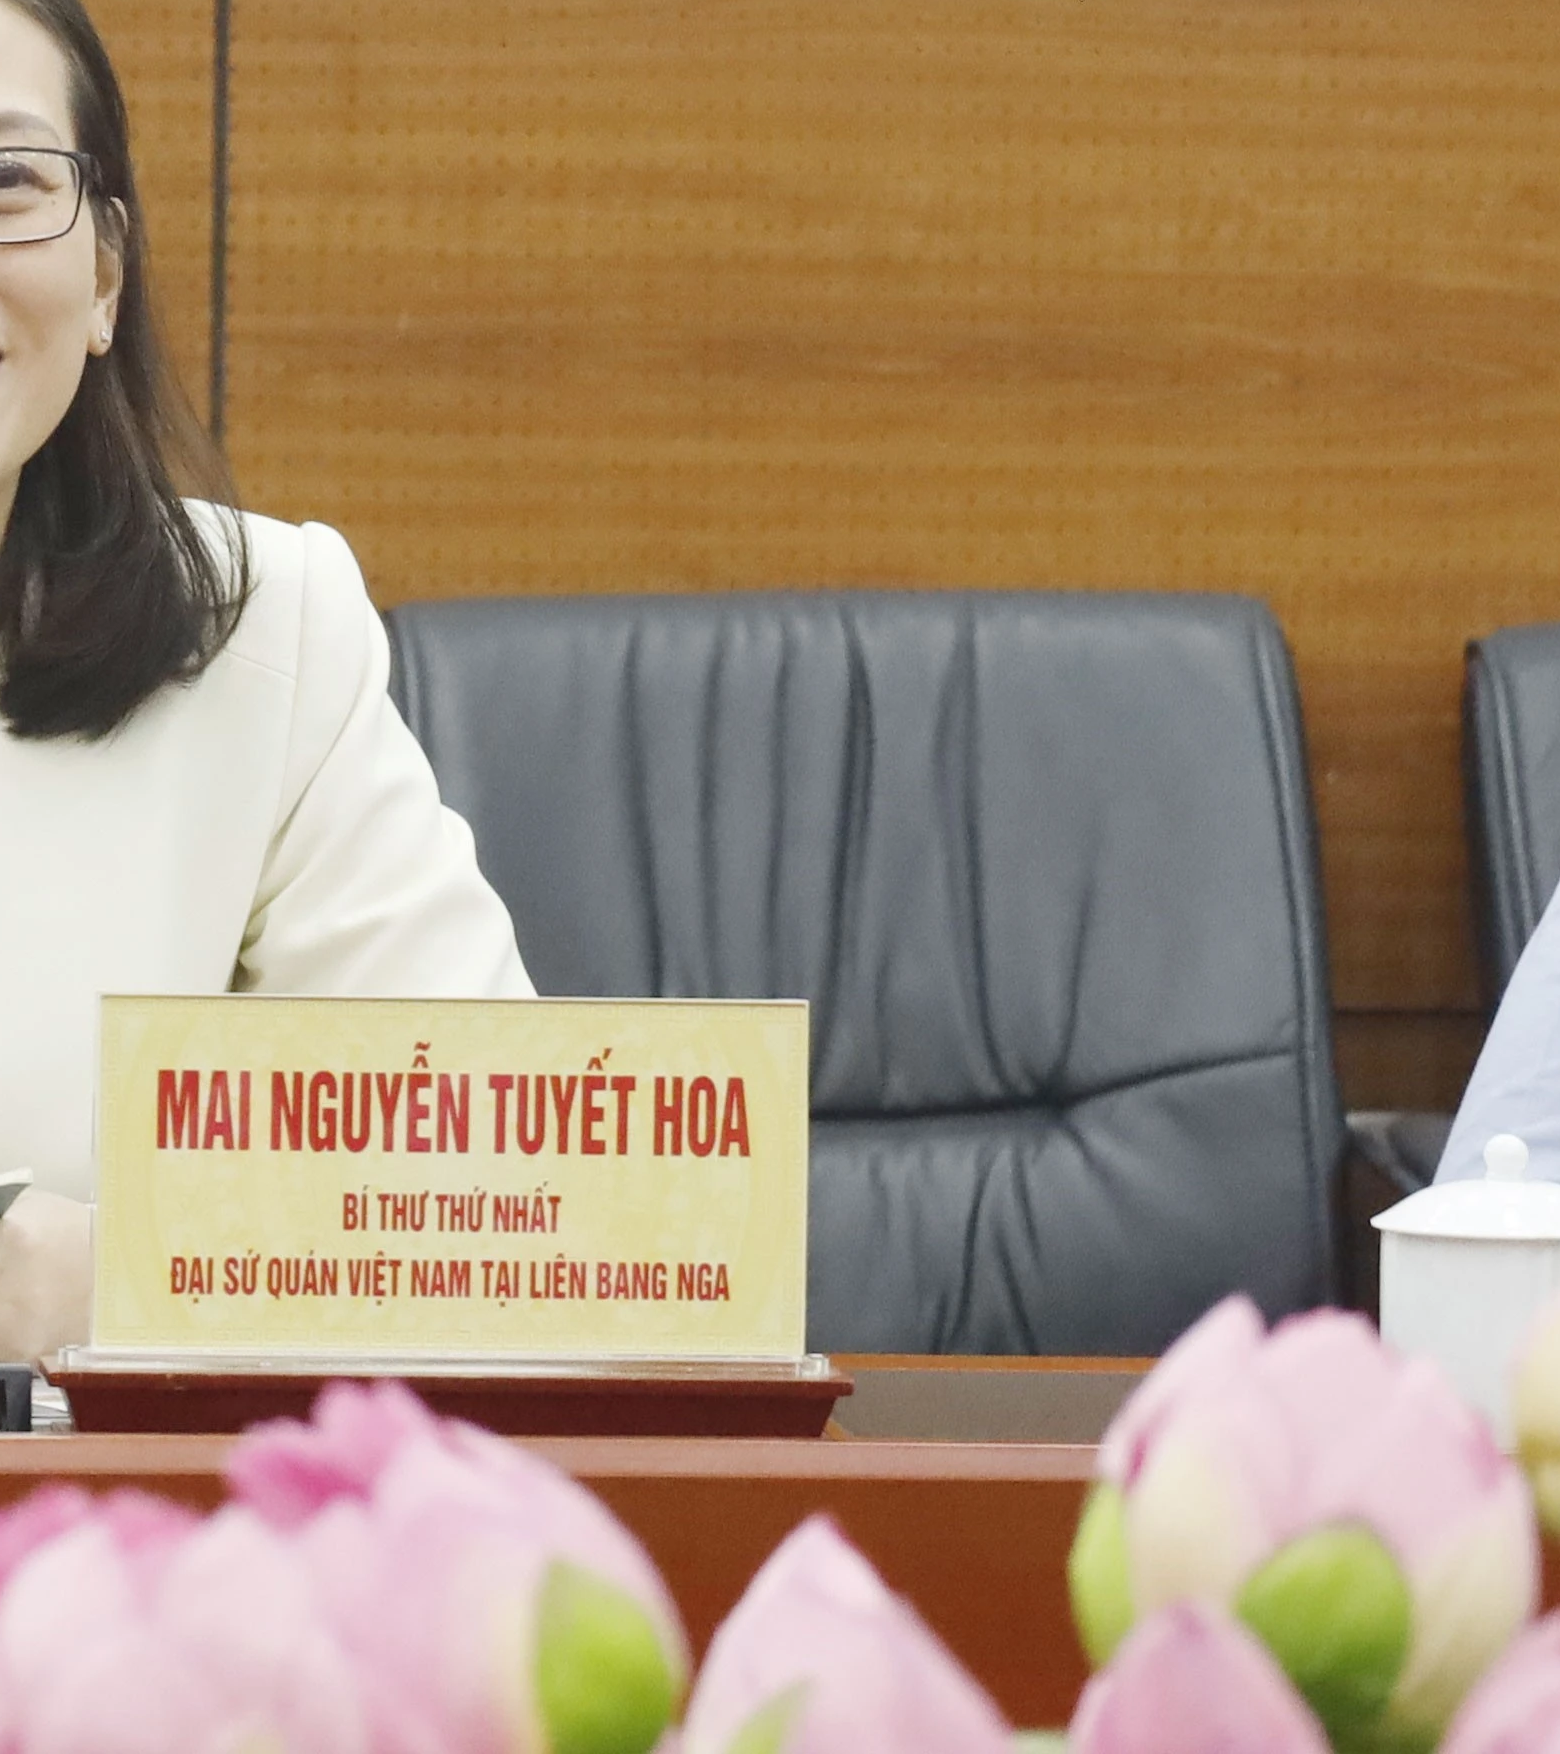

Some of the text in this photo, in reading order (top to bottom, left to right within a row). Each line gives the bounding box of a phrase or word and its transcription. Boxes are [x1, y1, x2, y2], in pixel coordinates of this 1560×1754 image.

[156, 1041, 751, 1158] MAI NGUYỄN TUYẾT HOA
[342, 1181, 562, 1233] BÍ THƯ THỨ NHẤT
[170, 1248, 730, 1307] ĐẠI SỨ QUÁN VIỆT NAM TẠI LIÊN BANG NGA
